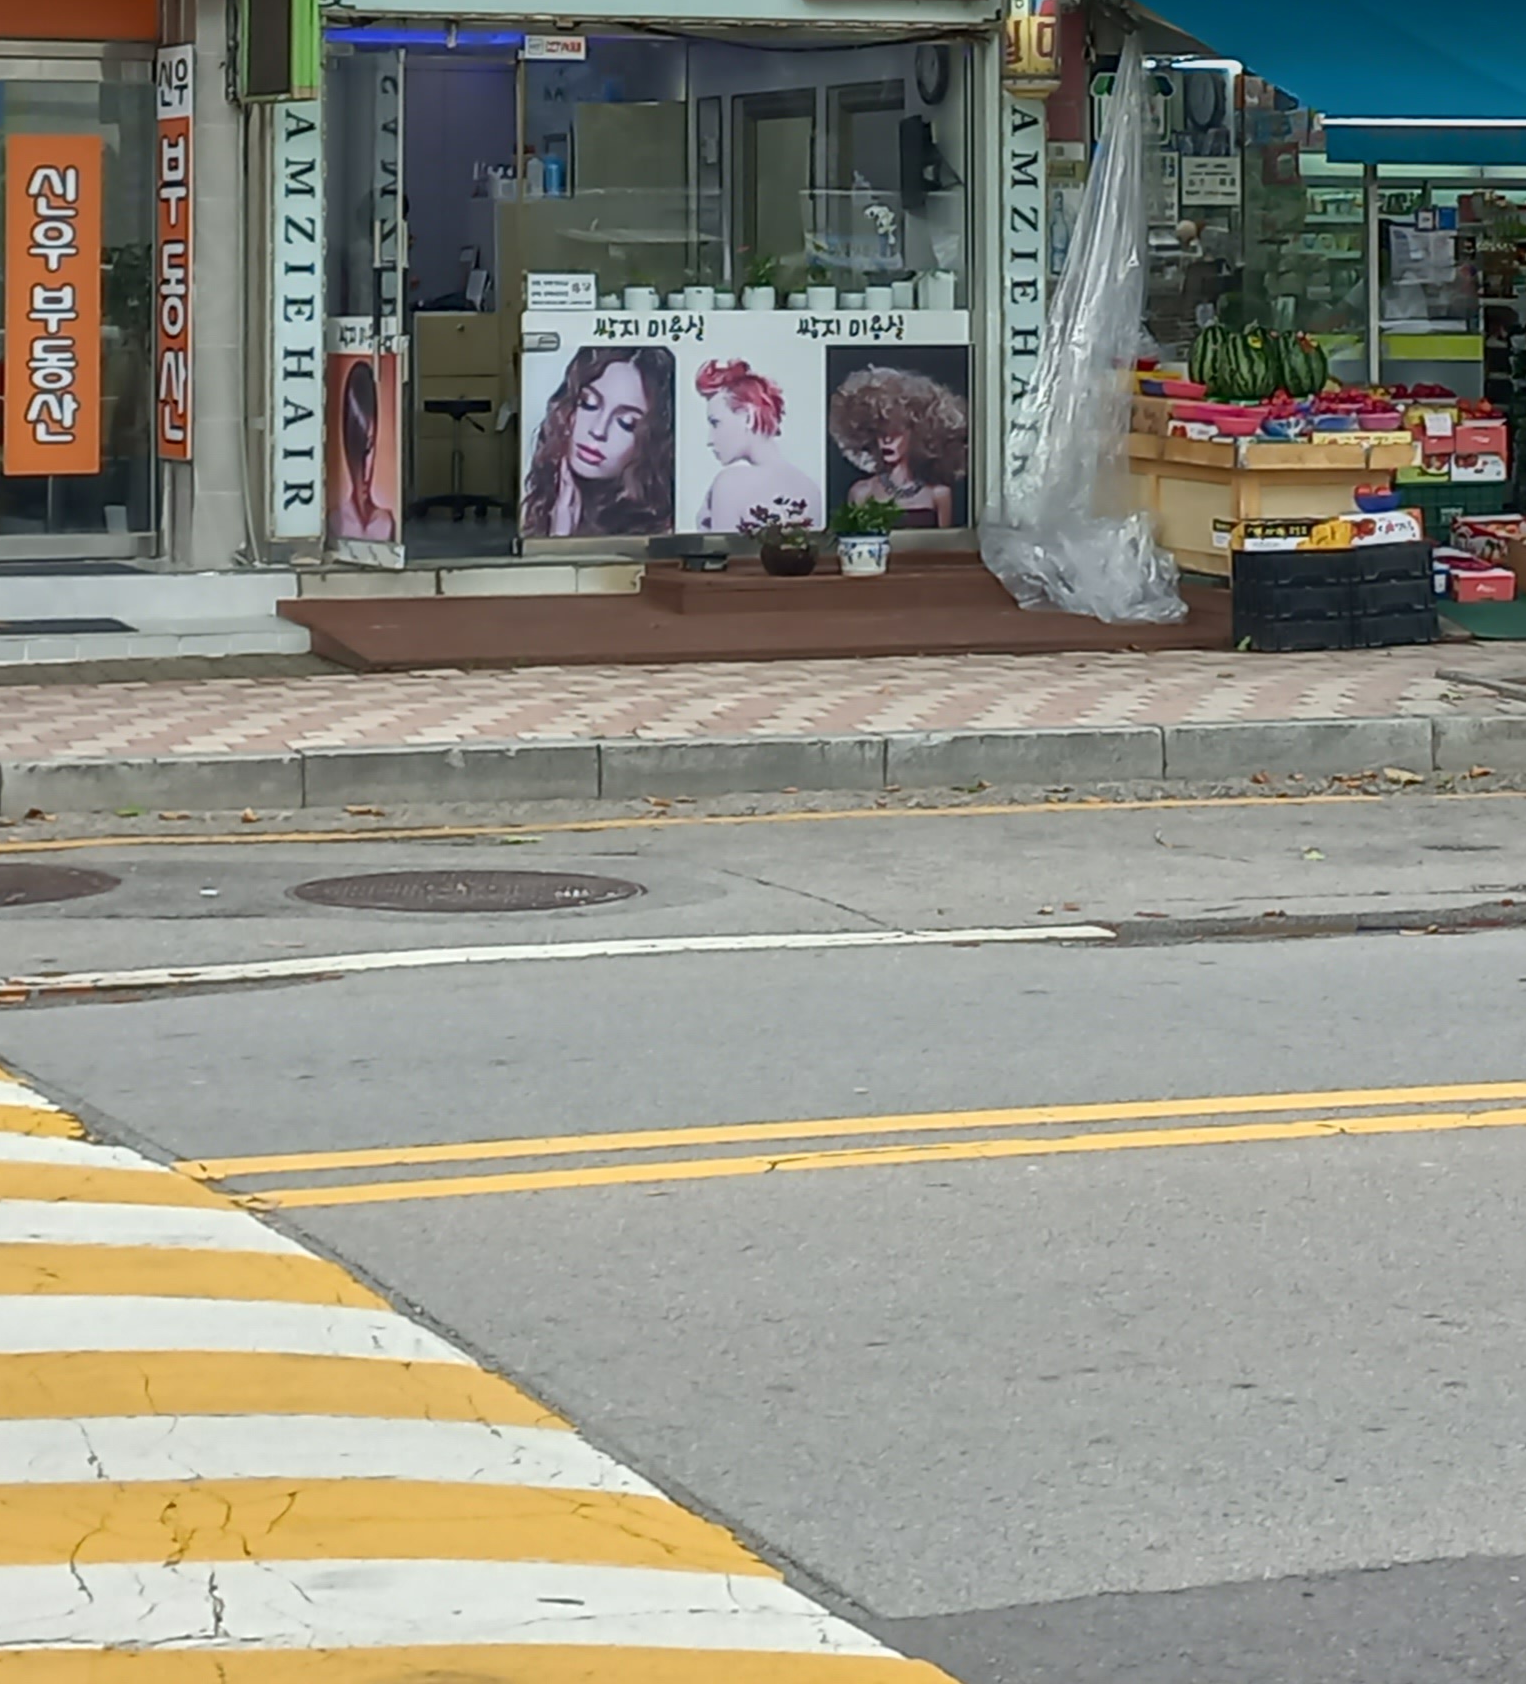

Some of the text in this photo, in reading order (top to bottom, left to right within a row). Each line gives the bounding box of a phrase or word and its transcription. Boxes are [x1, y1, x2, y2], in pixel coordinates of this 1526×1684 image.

[159, 57, 189, 108] 신우
[27, 165, 79, 444] 신우 부동산
[160, 134, 189, 444] 부동산
